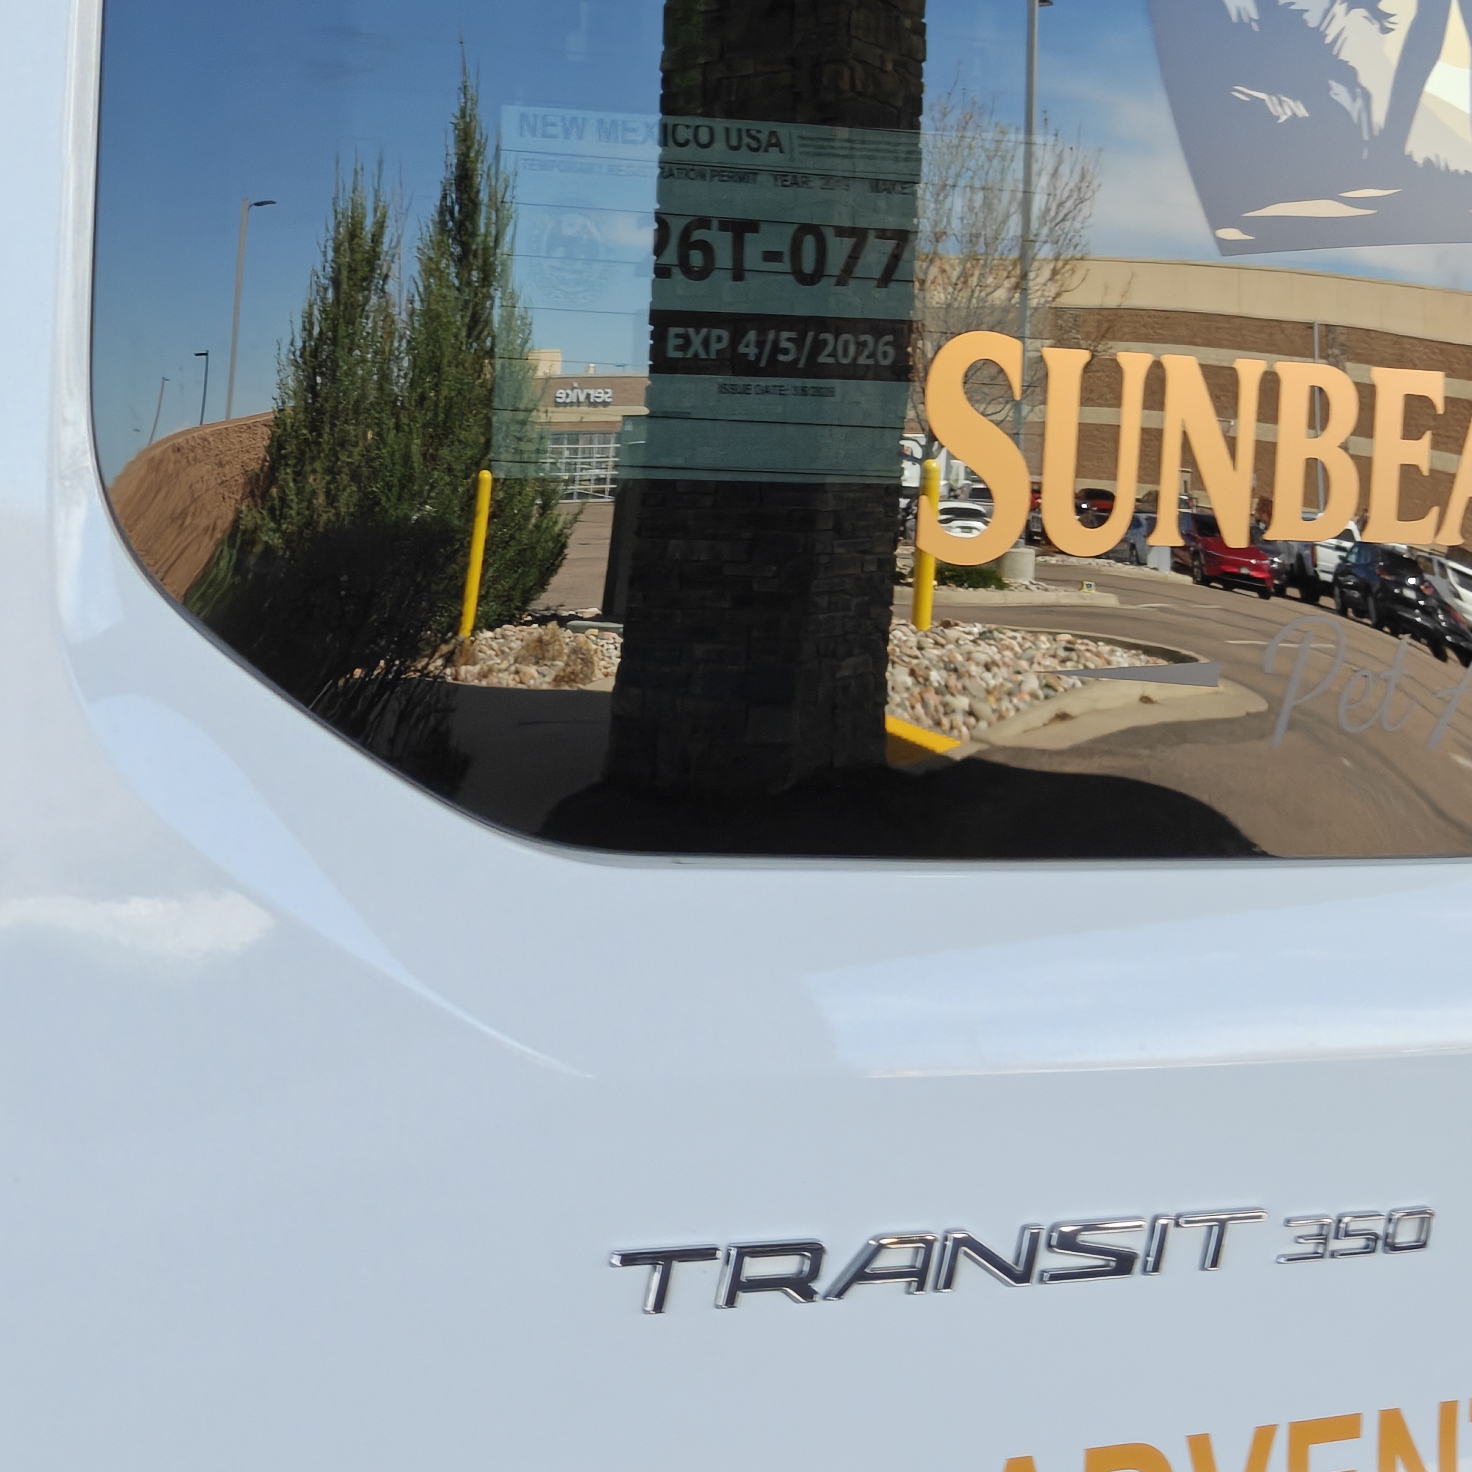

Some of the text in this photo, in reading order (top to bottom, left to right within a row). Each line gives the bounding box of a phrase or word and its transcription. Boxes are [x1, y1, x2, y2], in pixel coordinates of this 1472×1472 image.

[519, 111, 588, 142] NEW
[723, 126, 786, 155] USA
[666, 327, 895, 368] EXP 4/5/2026
[1261, 615, 1412, 750] Pet
[609, 1205, 1437, 1315] TRANSIT 350
